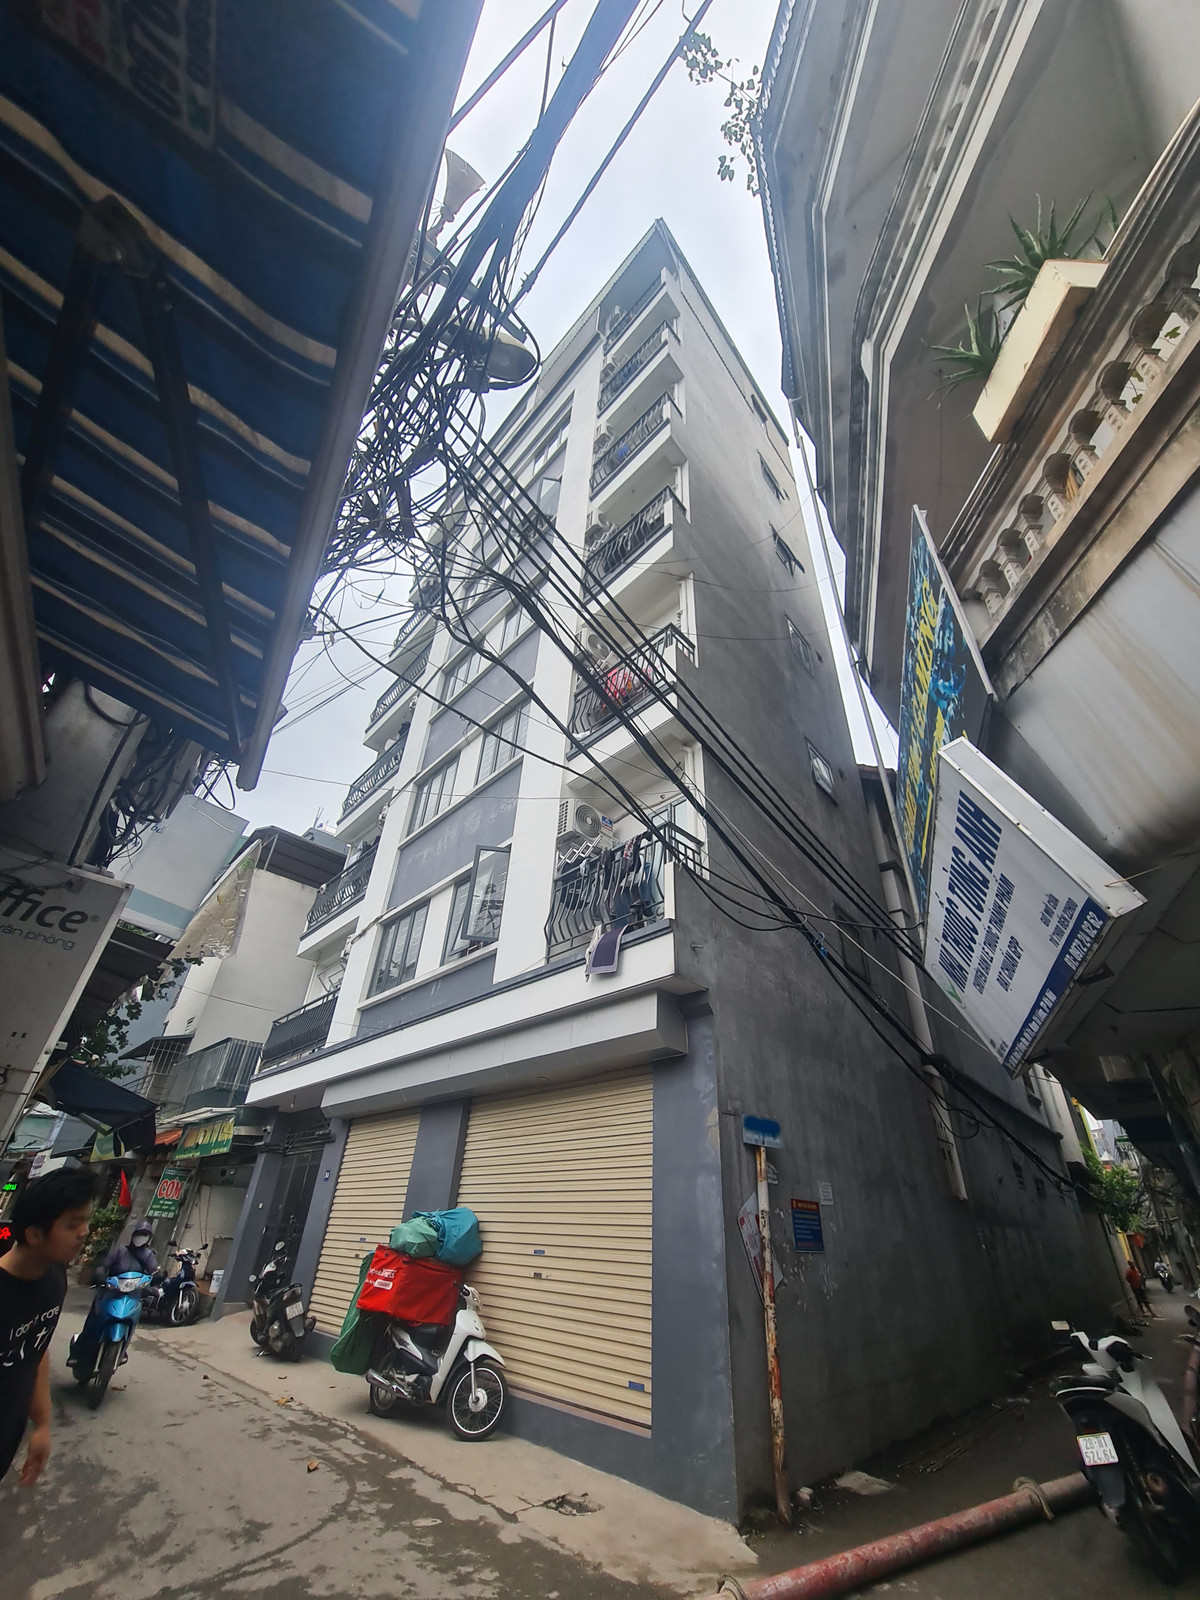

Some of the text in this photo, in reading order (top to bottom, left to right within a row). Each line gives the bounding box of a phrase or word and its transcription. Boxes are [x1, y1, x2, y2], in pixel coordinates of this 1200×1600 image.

[934, 788, 1002, 993] NHÀ THUỐC TÙNG ANH
[993, 872, 1015, 909] PHẨM
[988, 899, 1006, 933] THÀNH
[1086, 910, 1103, 929] 62
[983, 923, 999, 954] THUỐC
[1076, 930, 1092, 947] 24
[1081, 919, 1097, 938] 82
[24, 931, 76, 951] phòng
[1068, 938, 1087, 961] 0972
[996, 934, 1024, 992] ĐẠT CHUẨN GPP
[157, 1177, 185, 1200] CƠM
